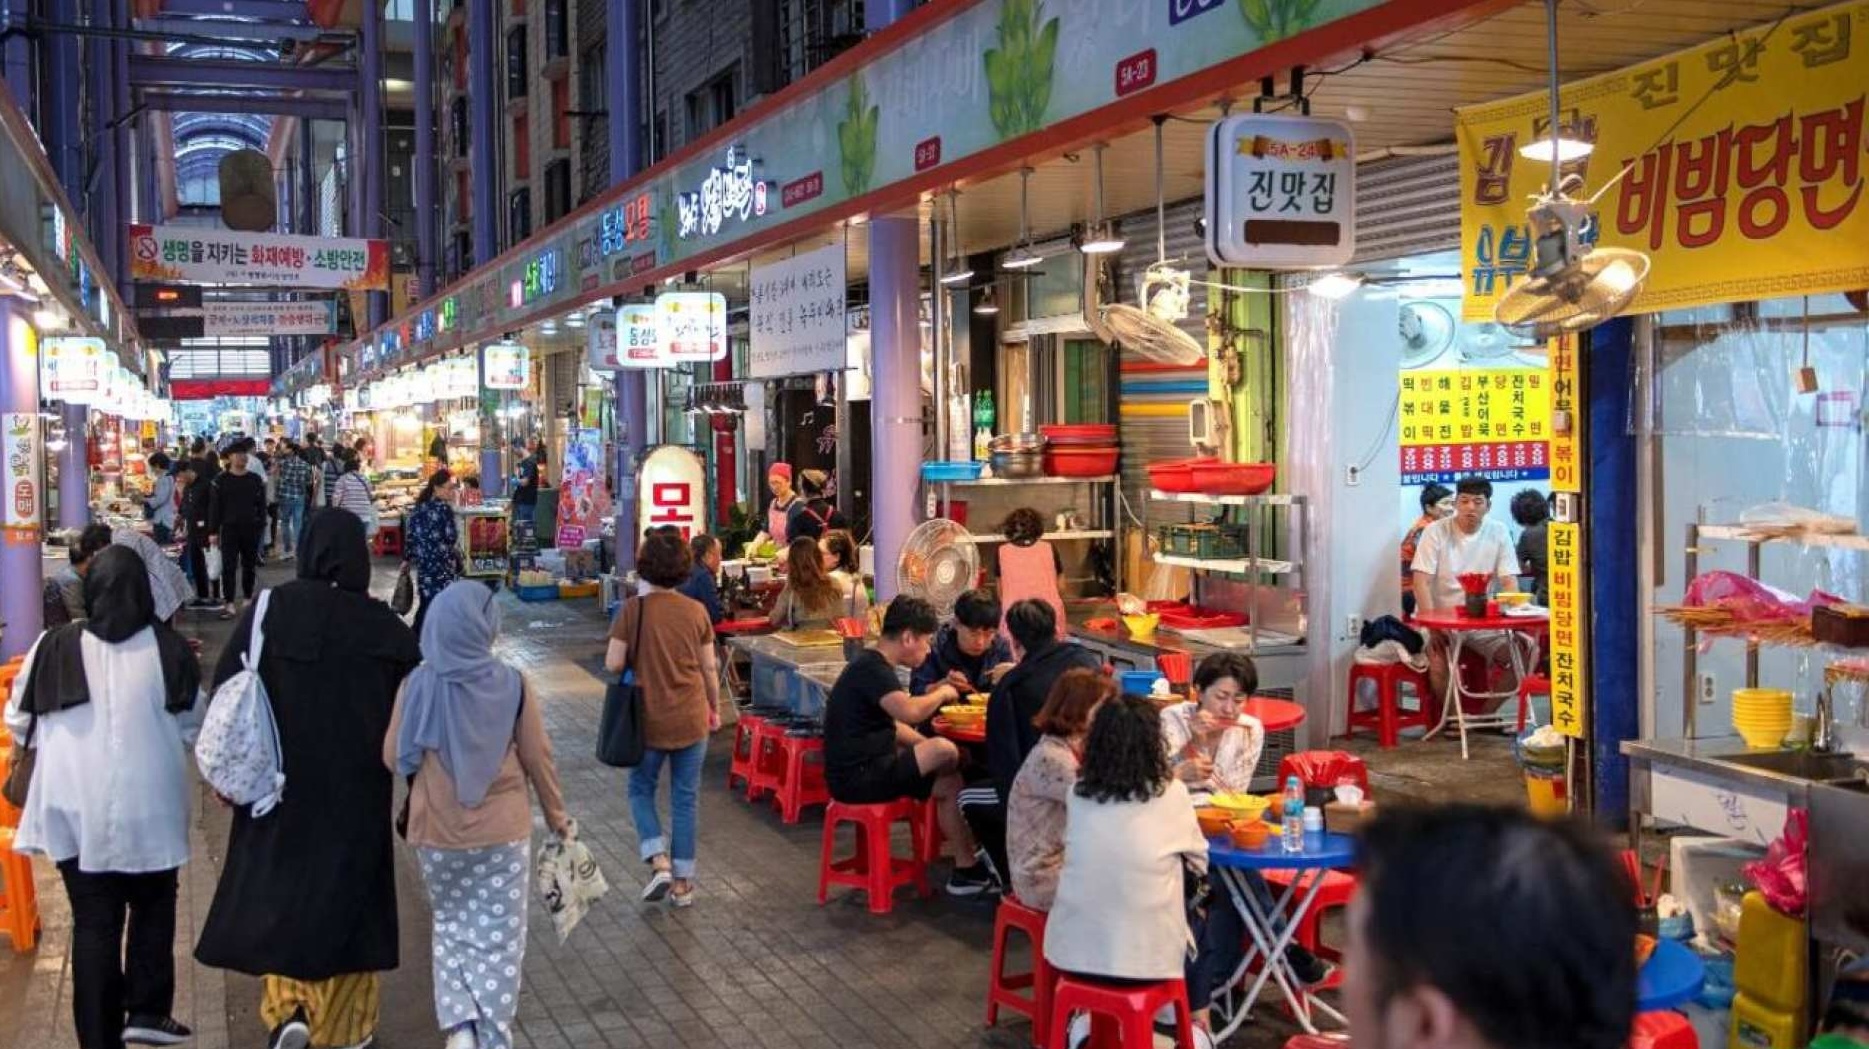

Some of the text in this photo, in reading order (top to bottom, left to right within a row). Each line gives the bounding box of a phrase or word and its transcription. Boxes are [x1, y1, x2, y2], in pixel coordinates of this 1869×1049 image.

[1631, 12, 1851, 110] 진맛집
[1268, 143, 1317, 158] 5A-24
[1617, 92, 1866, 252] 비빔당면
[1247, 170, 1337, 215] 진맛집
[162, 238, 367, 272] 생명을 지키는 화재예방 소방안전
[1477, 375, 1490, 437] 부산어묵
[1512, 374, 1525, 438] 잔치국수
[650, 482, 694, 547] 모
[1553, 529, 1575, 728] 김밥 비빔당면 잔치국수
